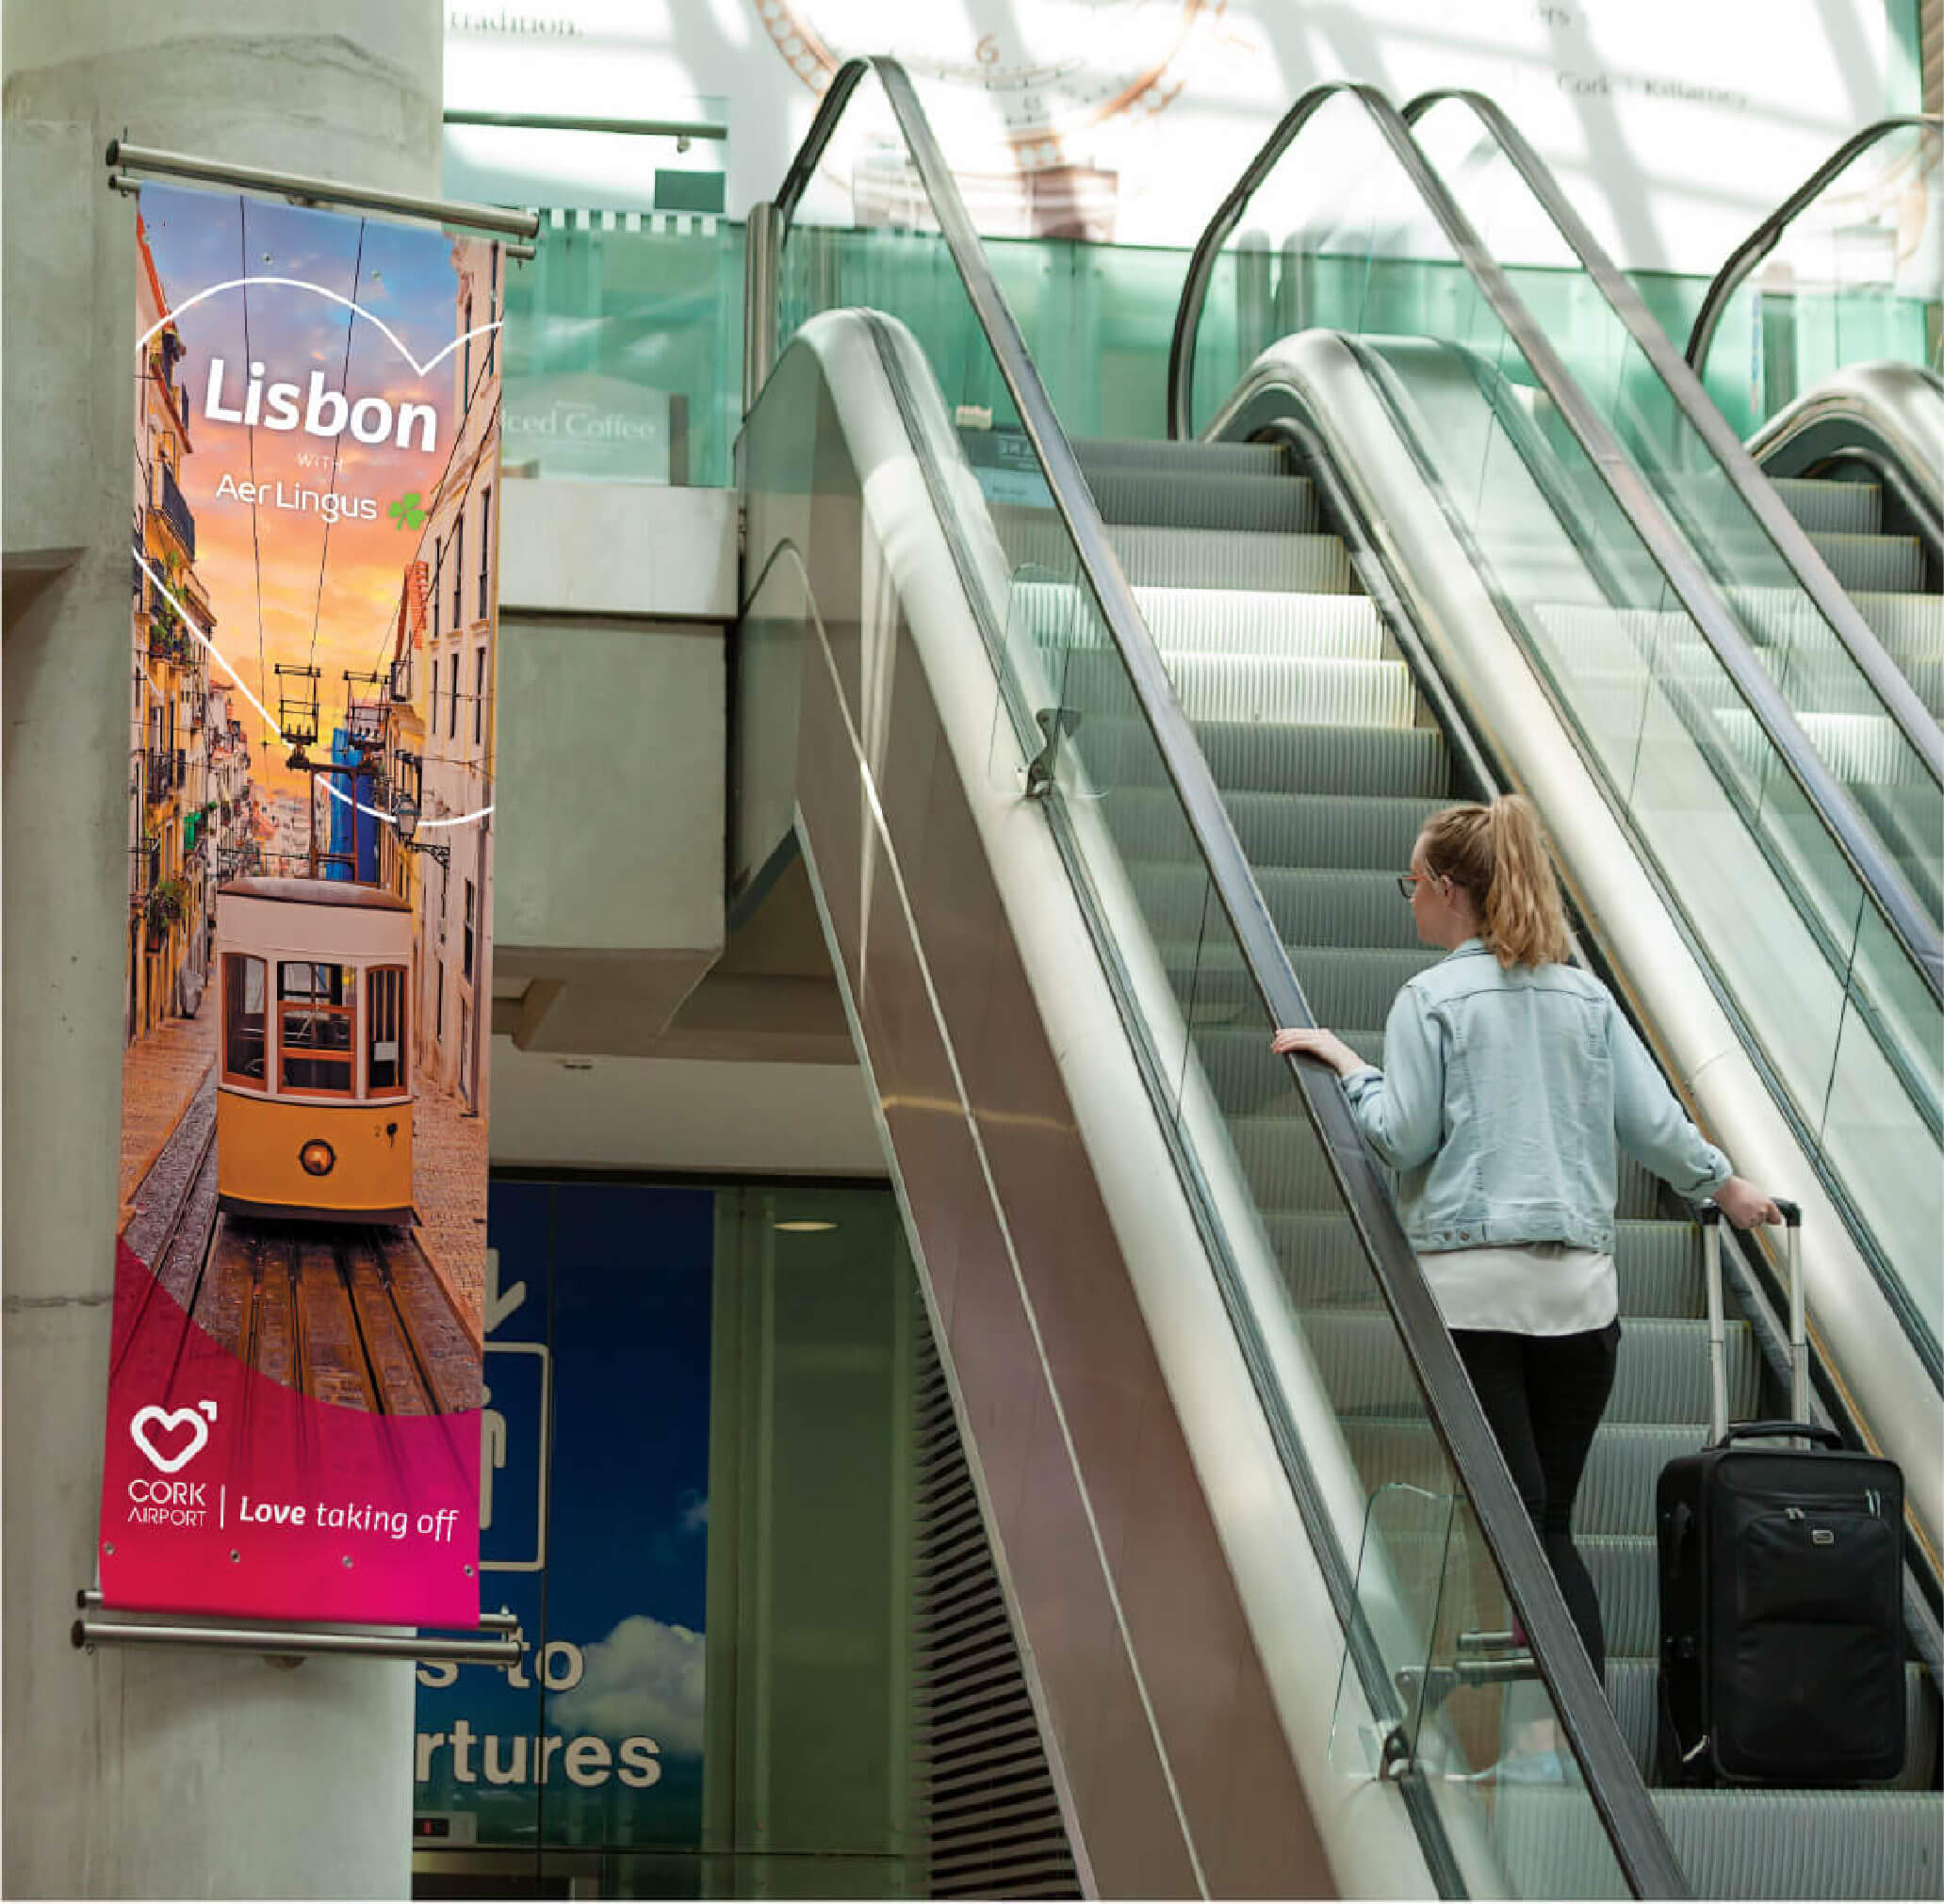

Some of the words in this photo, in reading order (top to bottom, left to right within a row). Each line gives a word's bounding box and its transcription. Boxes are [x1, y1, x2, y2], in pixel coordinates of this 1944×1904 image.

[204, 358, 437, 452] Lisbon
[564, 412, 657, 441] Coffee
[296, 453, 343, 470] WITH
[216, 474, 271, 505] Aer
[276, 480, 378, 525] Lingus
[127, 1478, 206, 1507] CORK
[127, 1506, 209, 1528] AIRPORT
[239, 1495, 306, 1526] Love
[317, 1502, 408, 1540] taking
[417, 1509, 459, 1542] off
[505, 1628, 584, 1691] to
